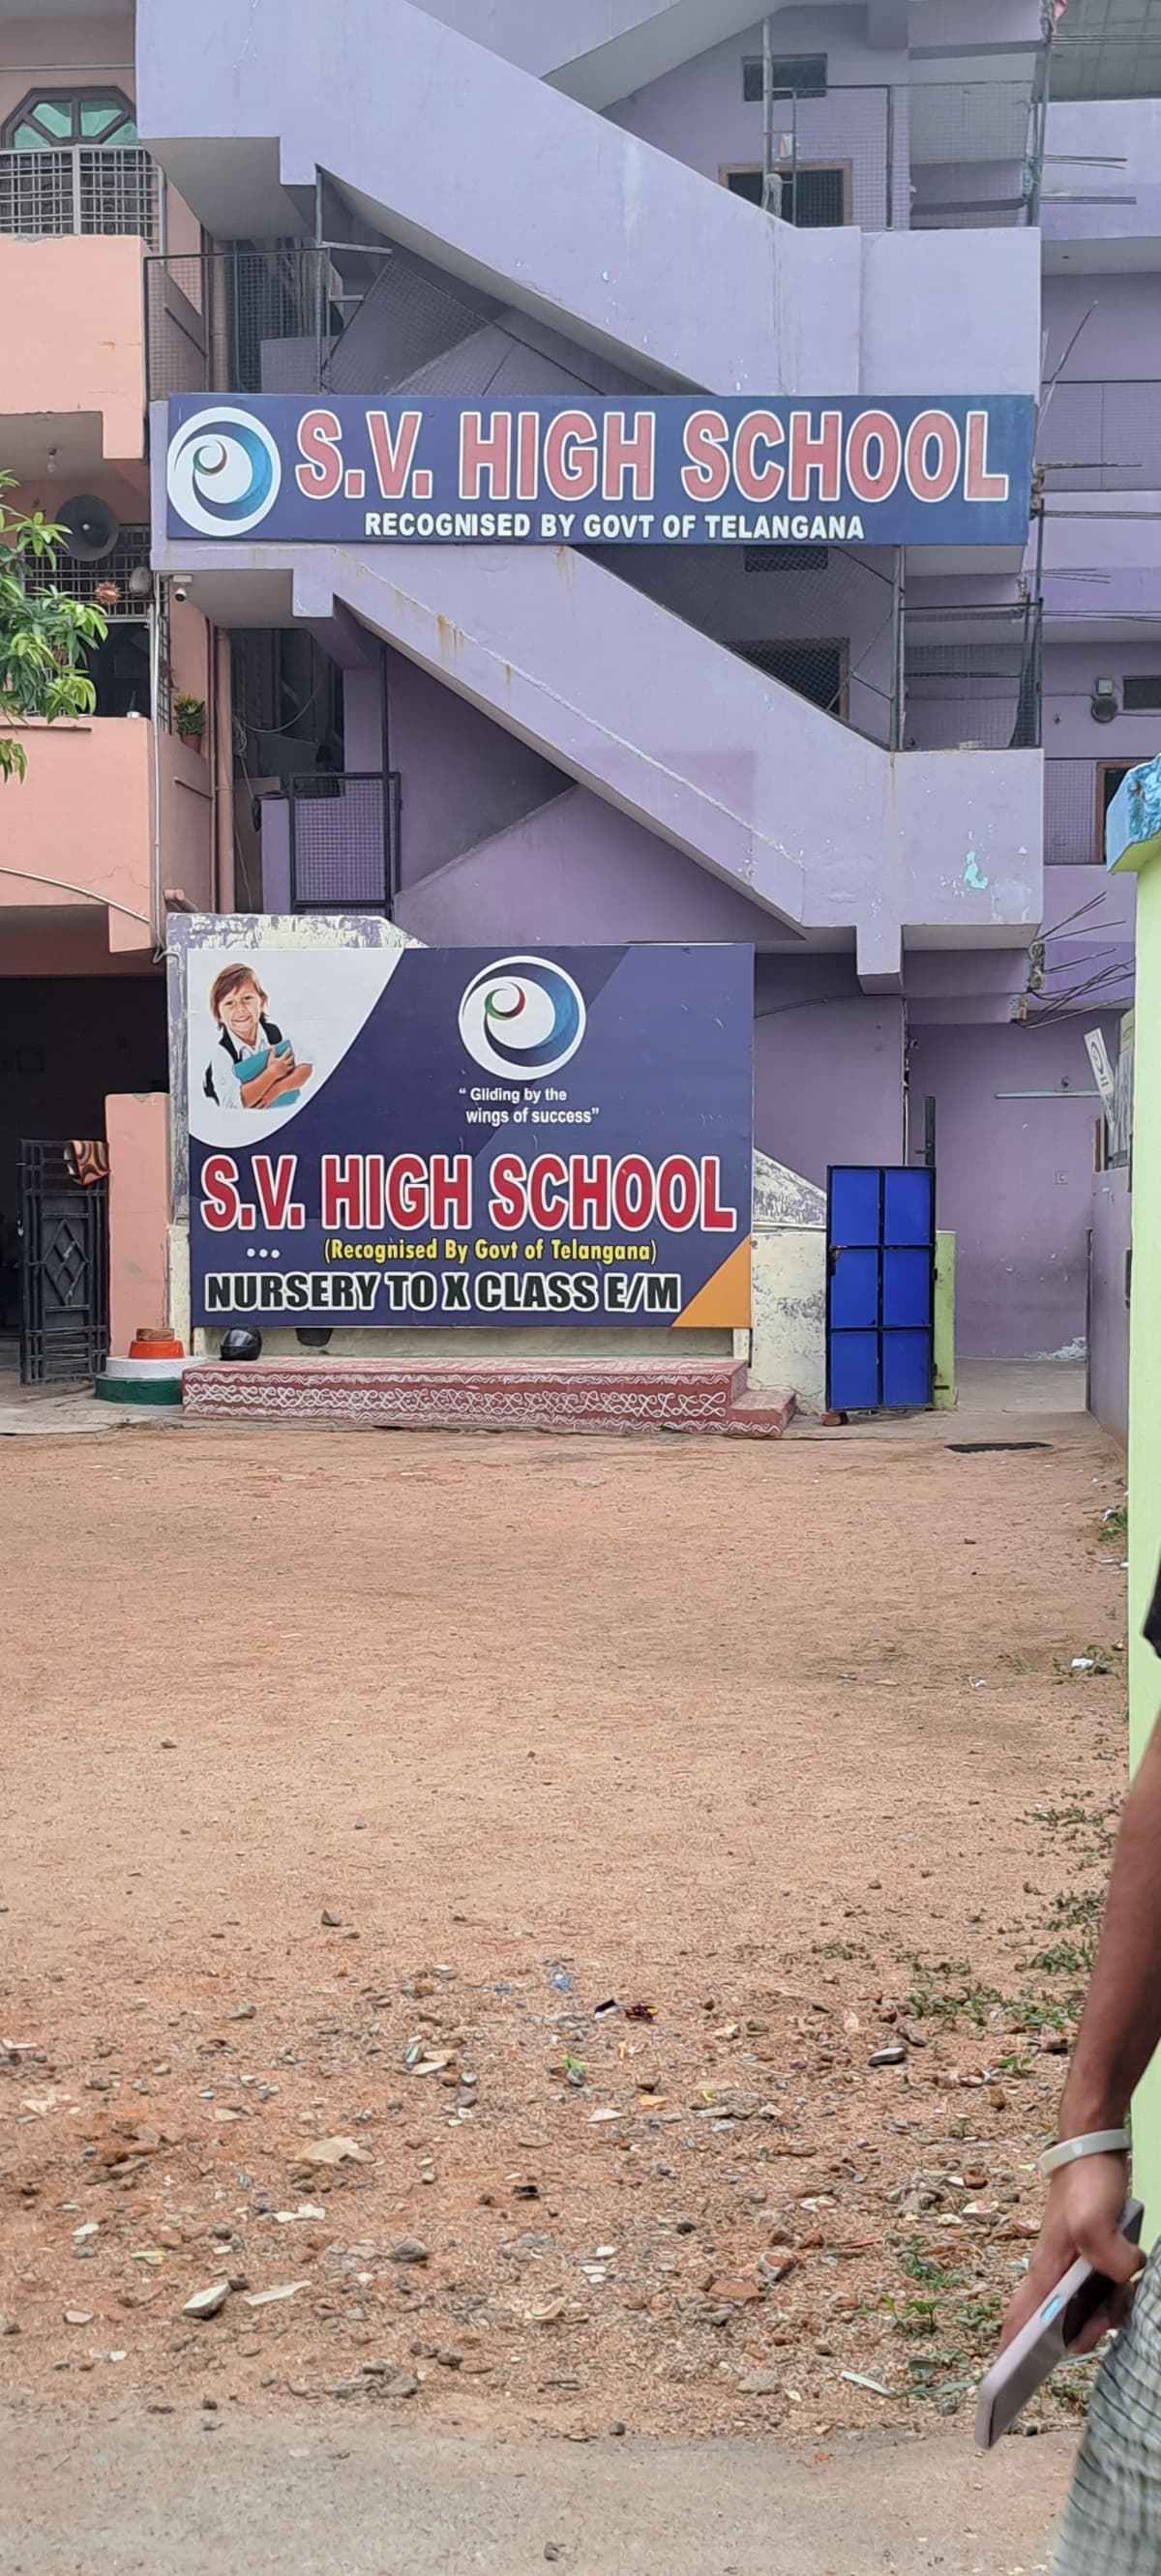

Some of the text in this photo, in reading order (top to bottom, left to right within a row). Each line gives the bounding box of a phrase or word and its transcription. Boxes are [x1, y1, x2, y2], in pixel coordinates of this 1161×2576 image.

[295, 409, 1009, 503] S.V. HIGH SCHOOL
[365, 512, 865, 540] RECOGNISED BY GOVT OF TELANGANA
[470, 1087, 521, 1104] Gliding
[524, 1087, 541, 1104] by
[545, 1087, 567, 1101] the
[466, 1108, 509, 1127] wings
[513, 1108, 528, 1123] of
[200, 1153, 736, 1231] S.V. HIGH SCHOOL
[324, 1238, 657, 1265] (Recognised By Govt of Telangana)
[205, 1271, 682, 1313] NURSERY TO X CLASS E/M
